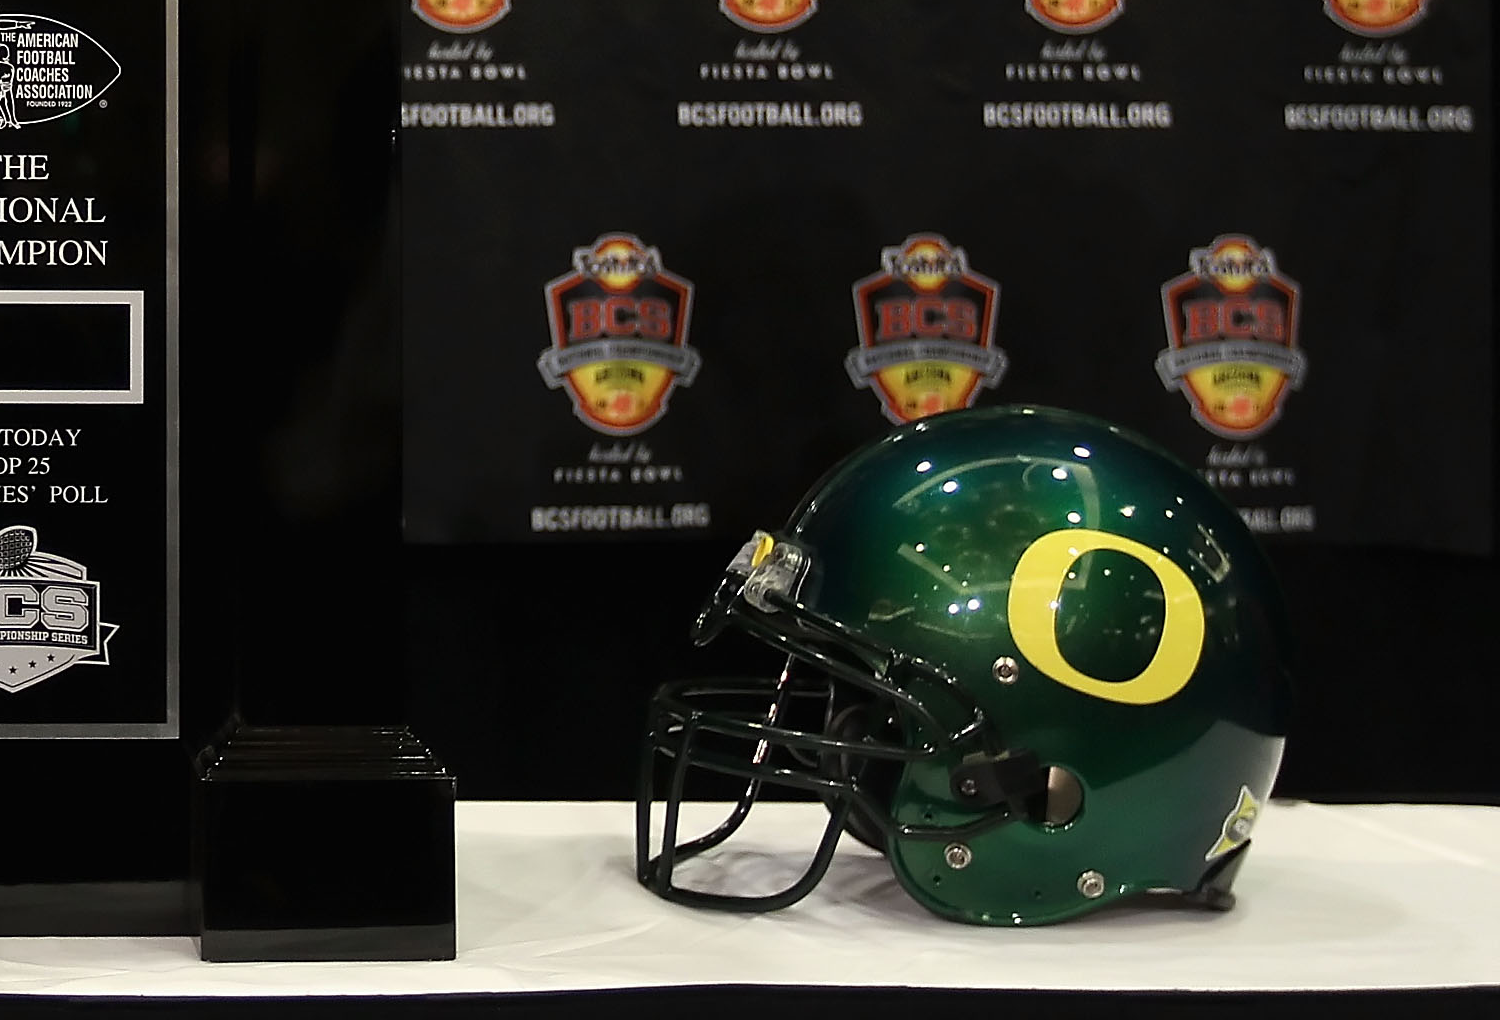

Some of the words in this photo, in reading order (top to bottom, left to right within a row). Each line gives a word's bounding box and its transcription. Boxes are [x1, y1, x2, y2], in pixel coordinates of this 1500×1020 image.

[0, 32, 16, 42] THE
[16, 32, 79, 48] AMERICAN
[16, 50, 76, 65] FOOTBALL
[16, 67, 69, 82] COACHES
[403, 64, 461, 80] IESTA
[15, 84, 93, 99] ASSOCIATION
[26, 100, 56, 108] FOUNDED
[57, 100, 72, 108] 1922
[571, 296, 670, 340] BCS
[878, 294, 978, 339] BCS
[27, 457, 51, 475] 25
[49, 485, 108, 503] POLL
[1007, 528, 1206, 706] O
[51, 632, 88, 645] SERIES
